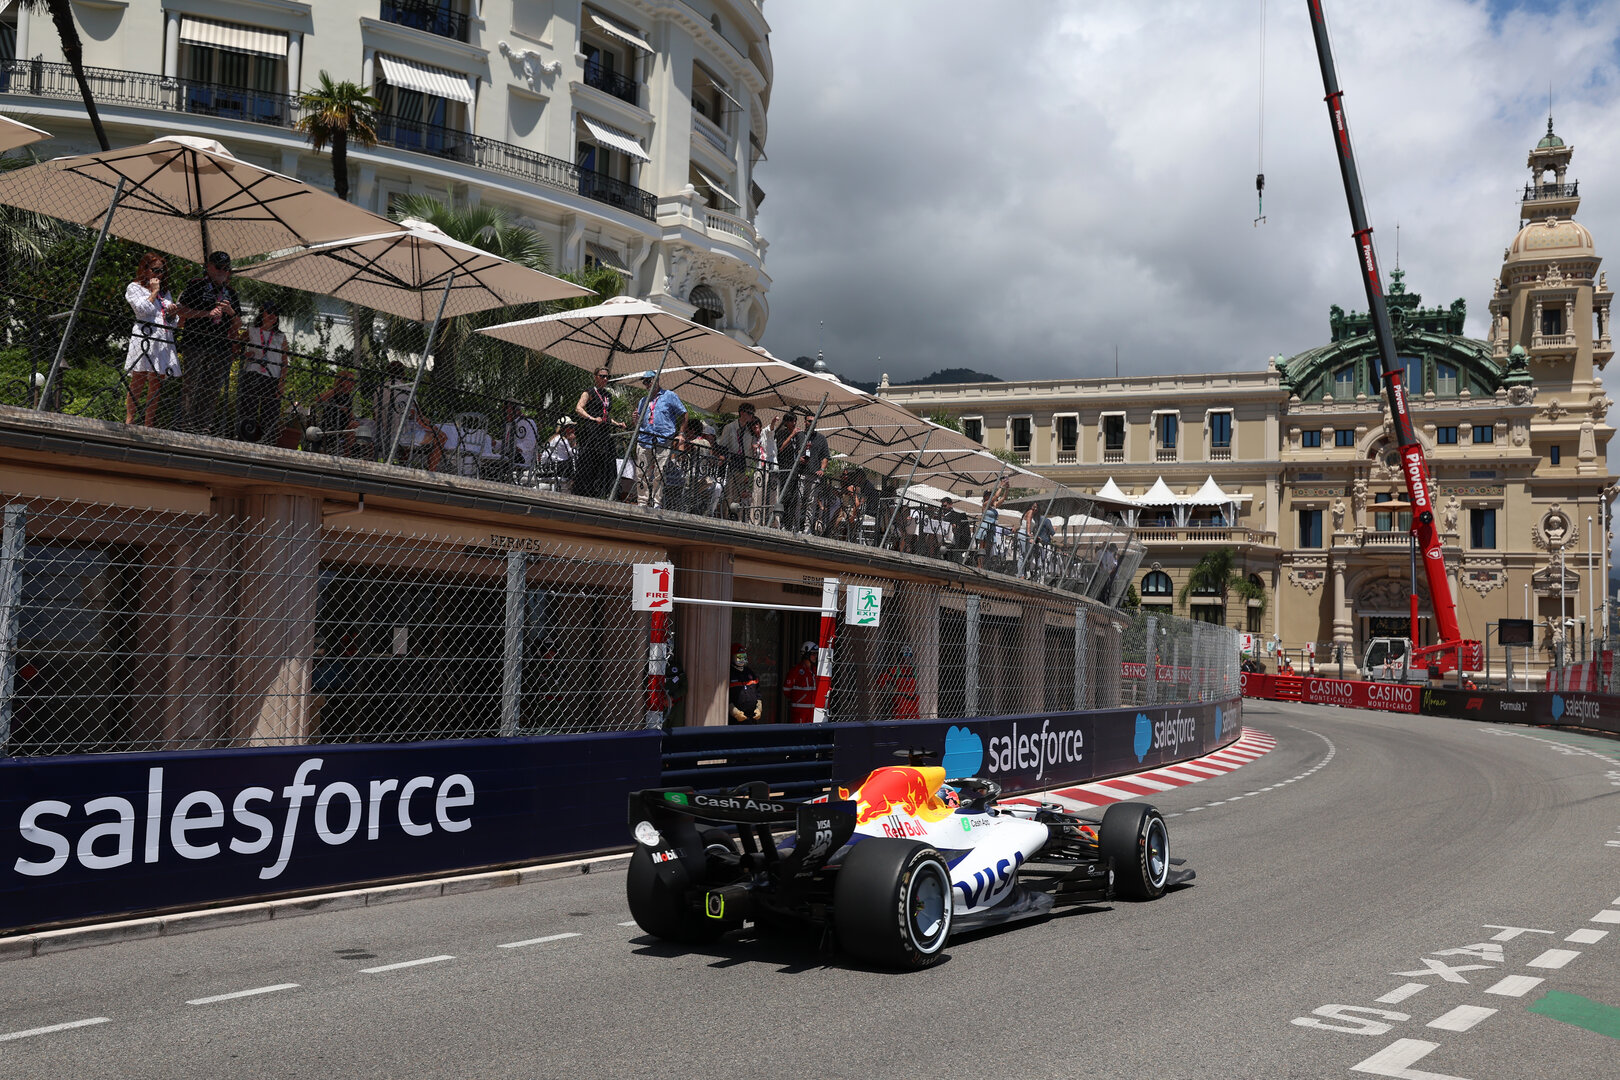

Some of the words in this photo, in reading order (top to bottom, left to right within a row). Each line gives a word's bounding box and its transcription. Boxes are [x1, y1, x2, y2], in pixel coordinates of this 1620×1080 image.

[1393, 384, 1405, 415] Piovano
[1406, 453, 1426, 506] Piovano
[1310, 680, 1353, 697] CASINO
[1368, 685, 1412, 703] CASINO
[1500, 700, 1521, 711] Formula
[1565, 695, 1600, 723] salesforce
[1154, 709, 1195, 755] salesforce
[988, 719, 1083, 780] salesforce
[695, 795, 740, 809] Cash
[744, 799, 784, 813] App
[14, 758, 475, 880] salesforce
[816, 819, 831, 830] VISA
[882, 821, 906, 838] Red
[906, 819, 928, 837] Bull
[970, 819, 981, 828] Cash
[898, 886, 907, 939] ZERO
